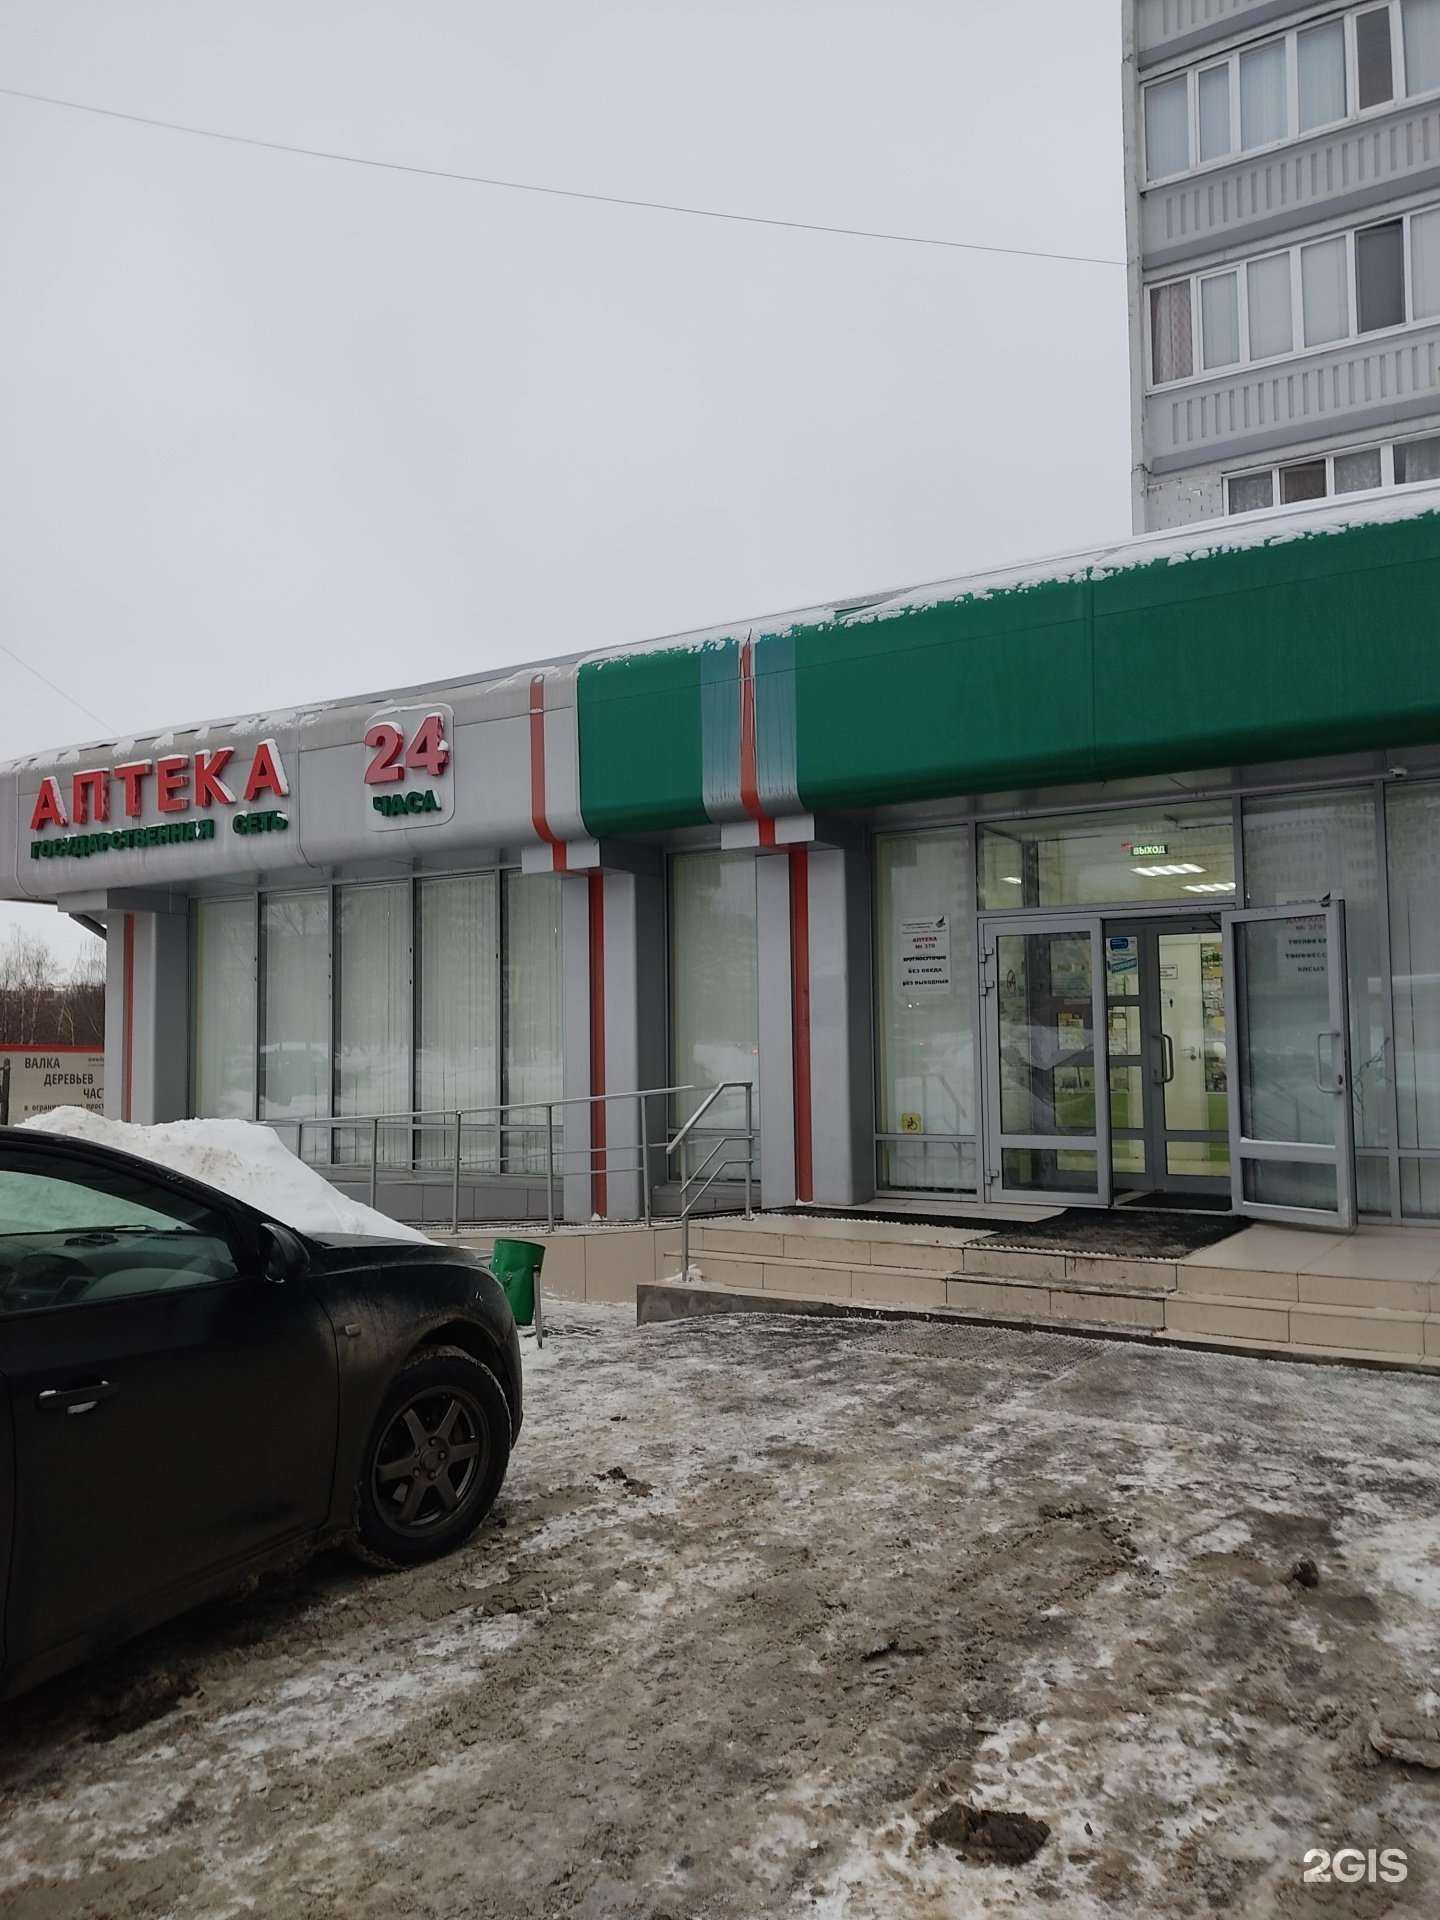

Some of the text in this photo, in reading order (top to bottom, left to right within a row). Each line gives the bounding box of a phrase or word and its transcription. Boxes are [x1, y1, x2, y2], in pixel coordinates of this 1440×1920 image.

[364, 712, 449, 785] 24
[30, 738, 289, 831] АПТЕКА
[372, 789, 442, 817] ЧАСА
[30, 809, 289, 859] ГОСУДАРСТВЕННАЯ СЕТЬ
[1133, 845, 1166, 855] ВЫХОД
[24, 1057, 61, 1069] ВАЛКА
[44, 1073, 94, 1087] ДЕРЕВЬЕВ
